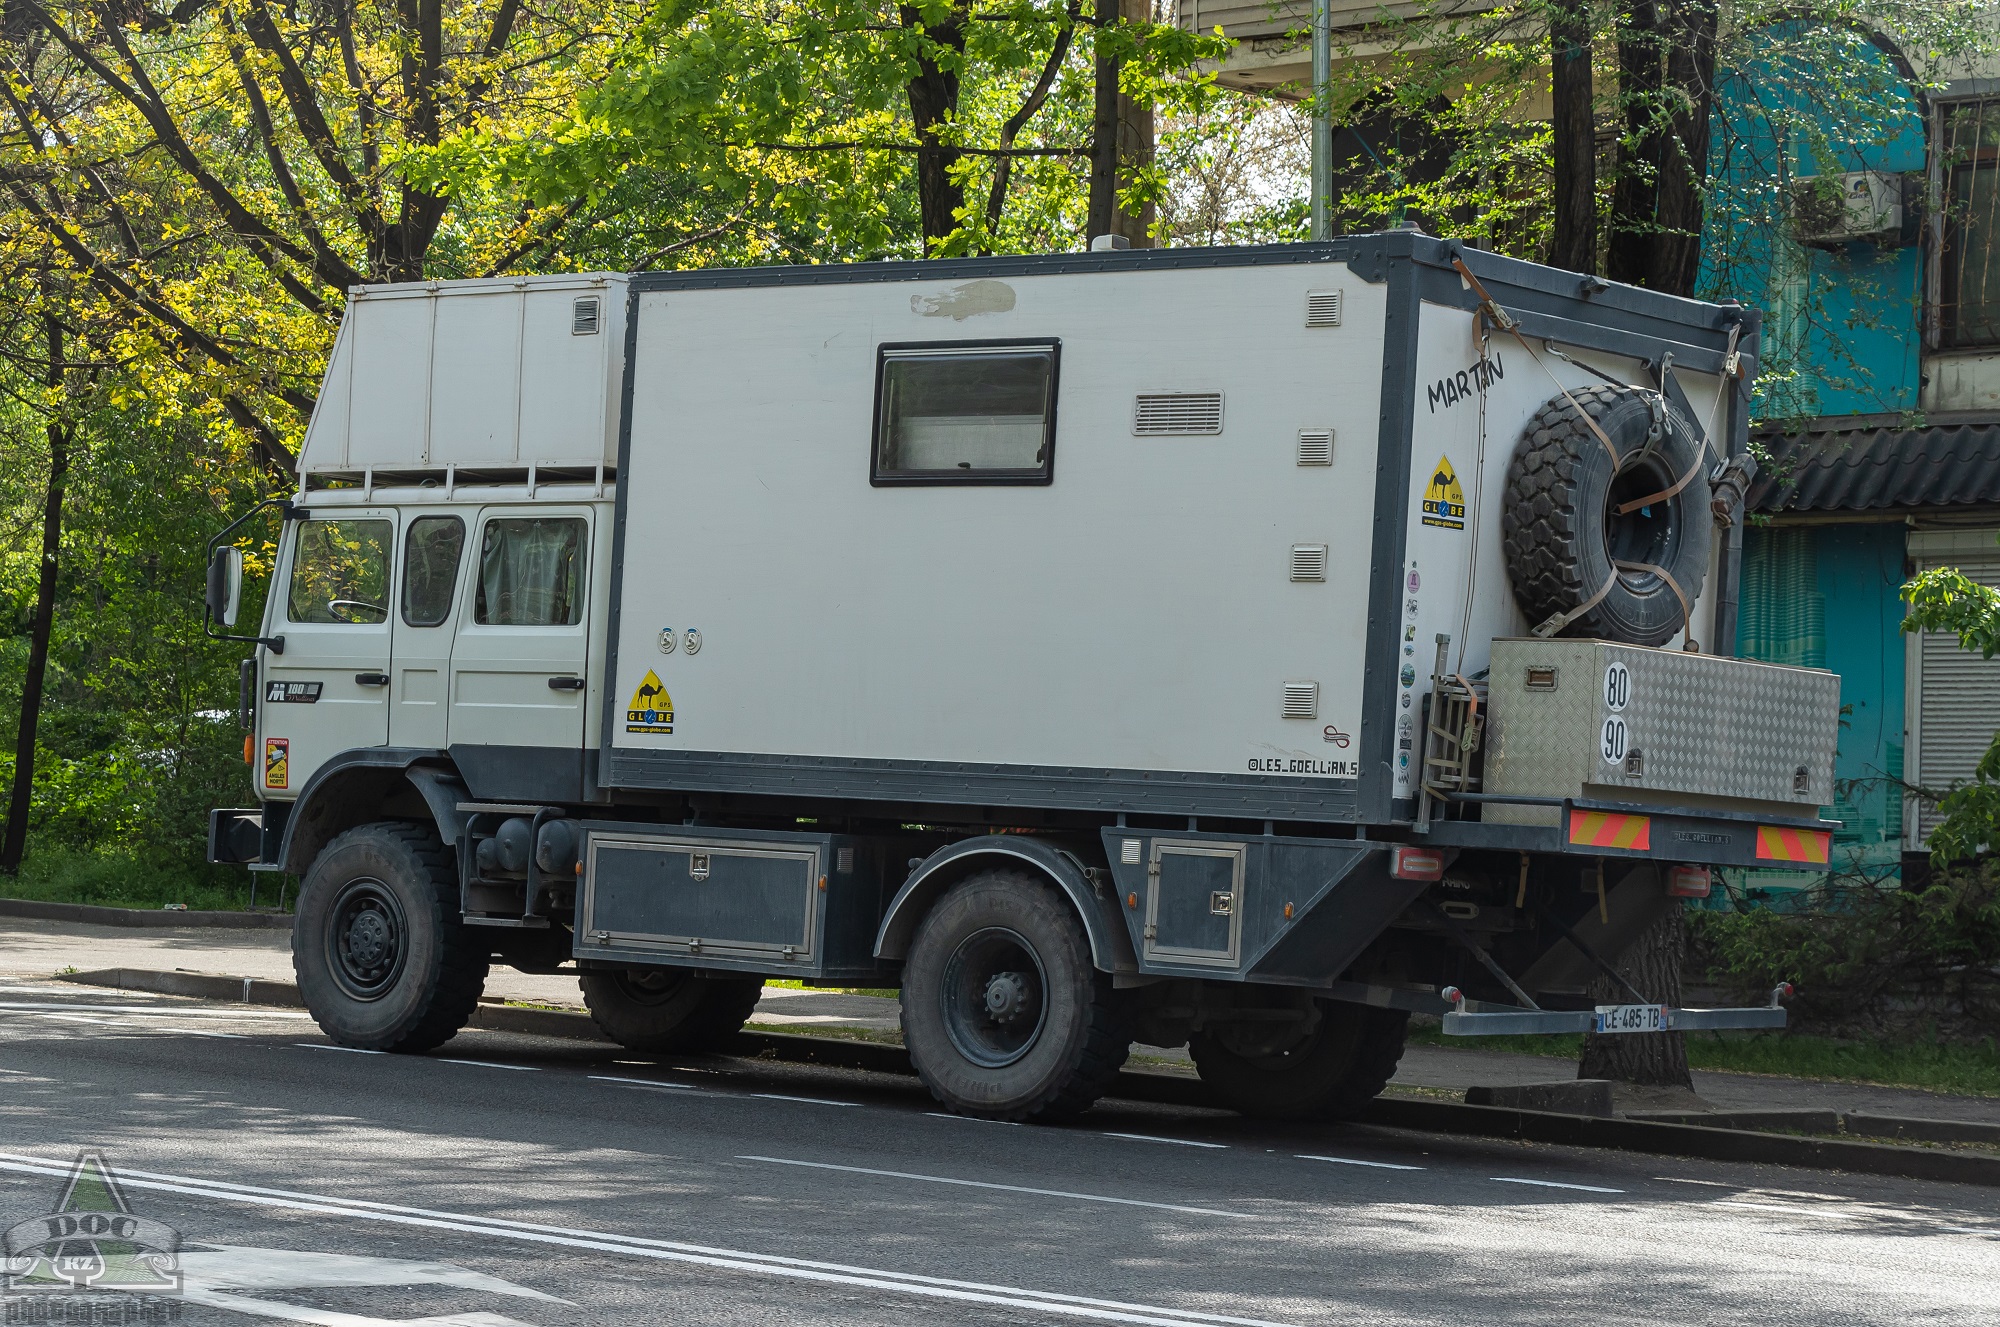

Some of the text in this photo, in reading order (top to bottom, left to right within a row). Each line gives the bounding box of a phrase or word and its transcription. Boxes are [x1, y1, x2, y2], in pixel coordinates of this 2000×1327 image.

[1427, 351, 1504, 414] MARTIN
[1451, 493, 1463, 501] GPS
[1607, 667, 1628, 707] 80
[1604, 719, 1625, 760] 90
